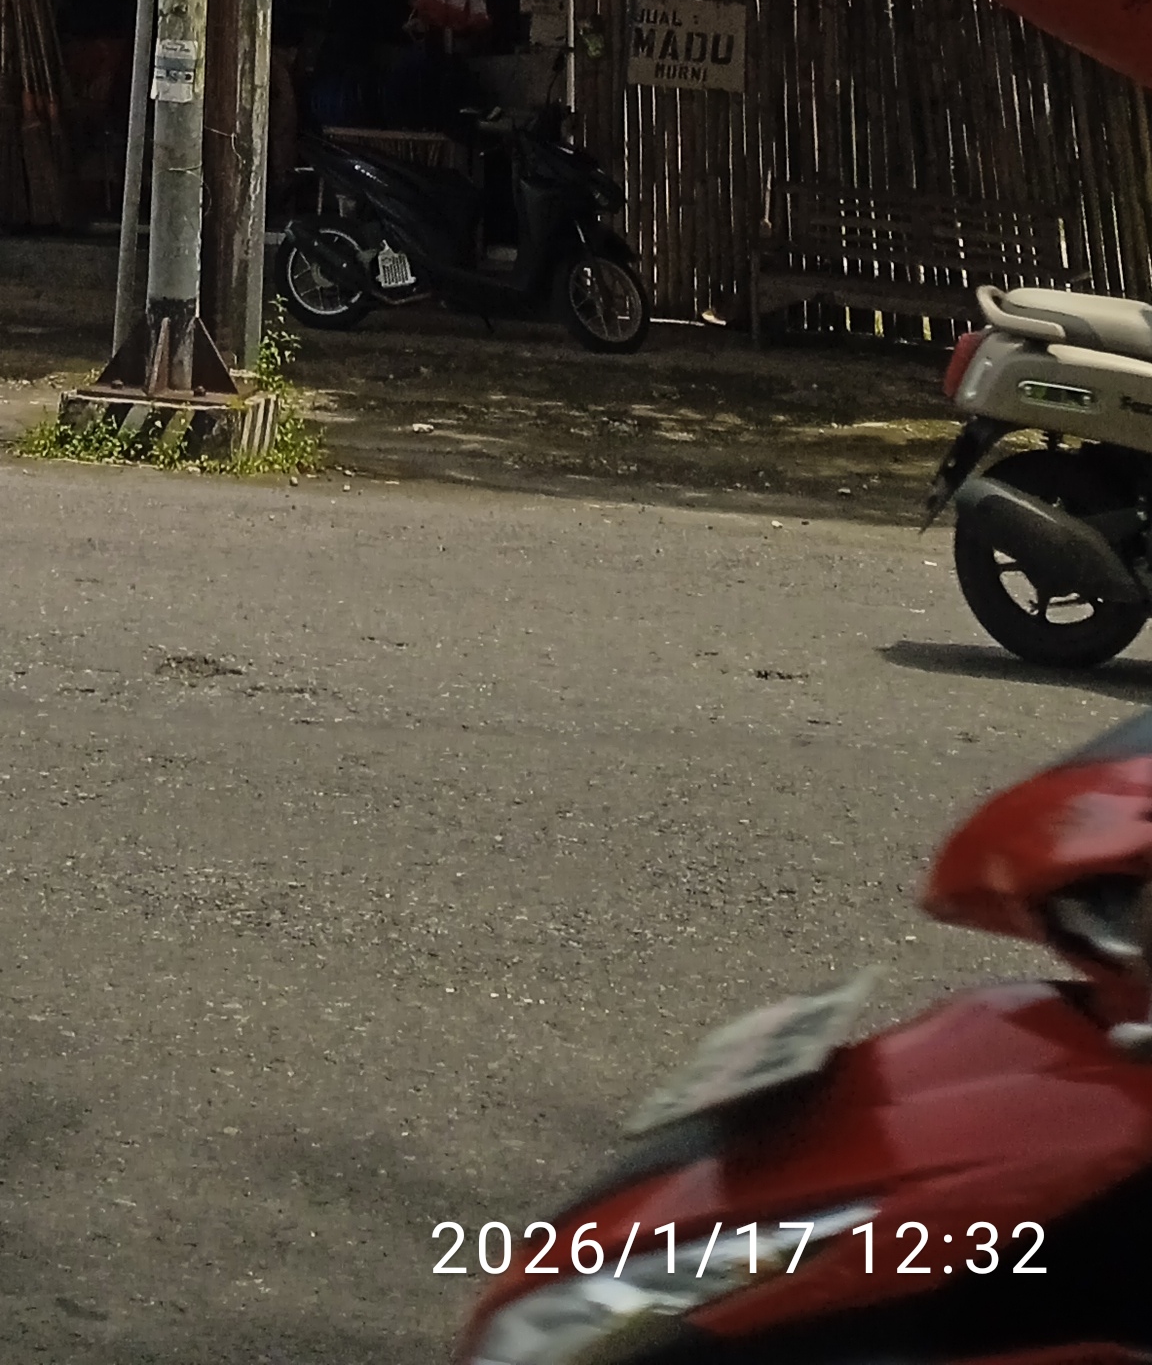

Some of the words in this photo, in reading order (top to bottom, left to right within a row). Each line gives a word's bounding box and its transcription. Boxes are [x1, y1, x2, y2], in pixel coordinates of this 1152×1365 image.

[637, 9, 682, 26] JUAL
[634, 27, 734, 65] MADU
[655, 62, 708, 81] MURNI
